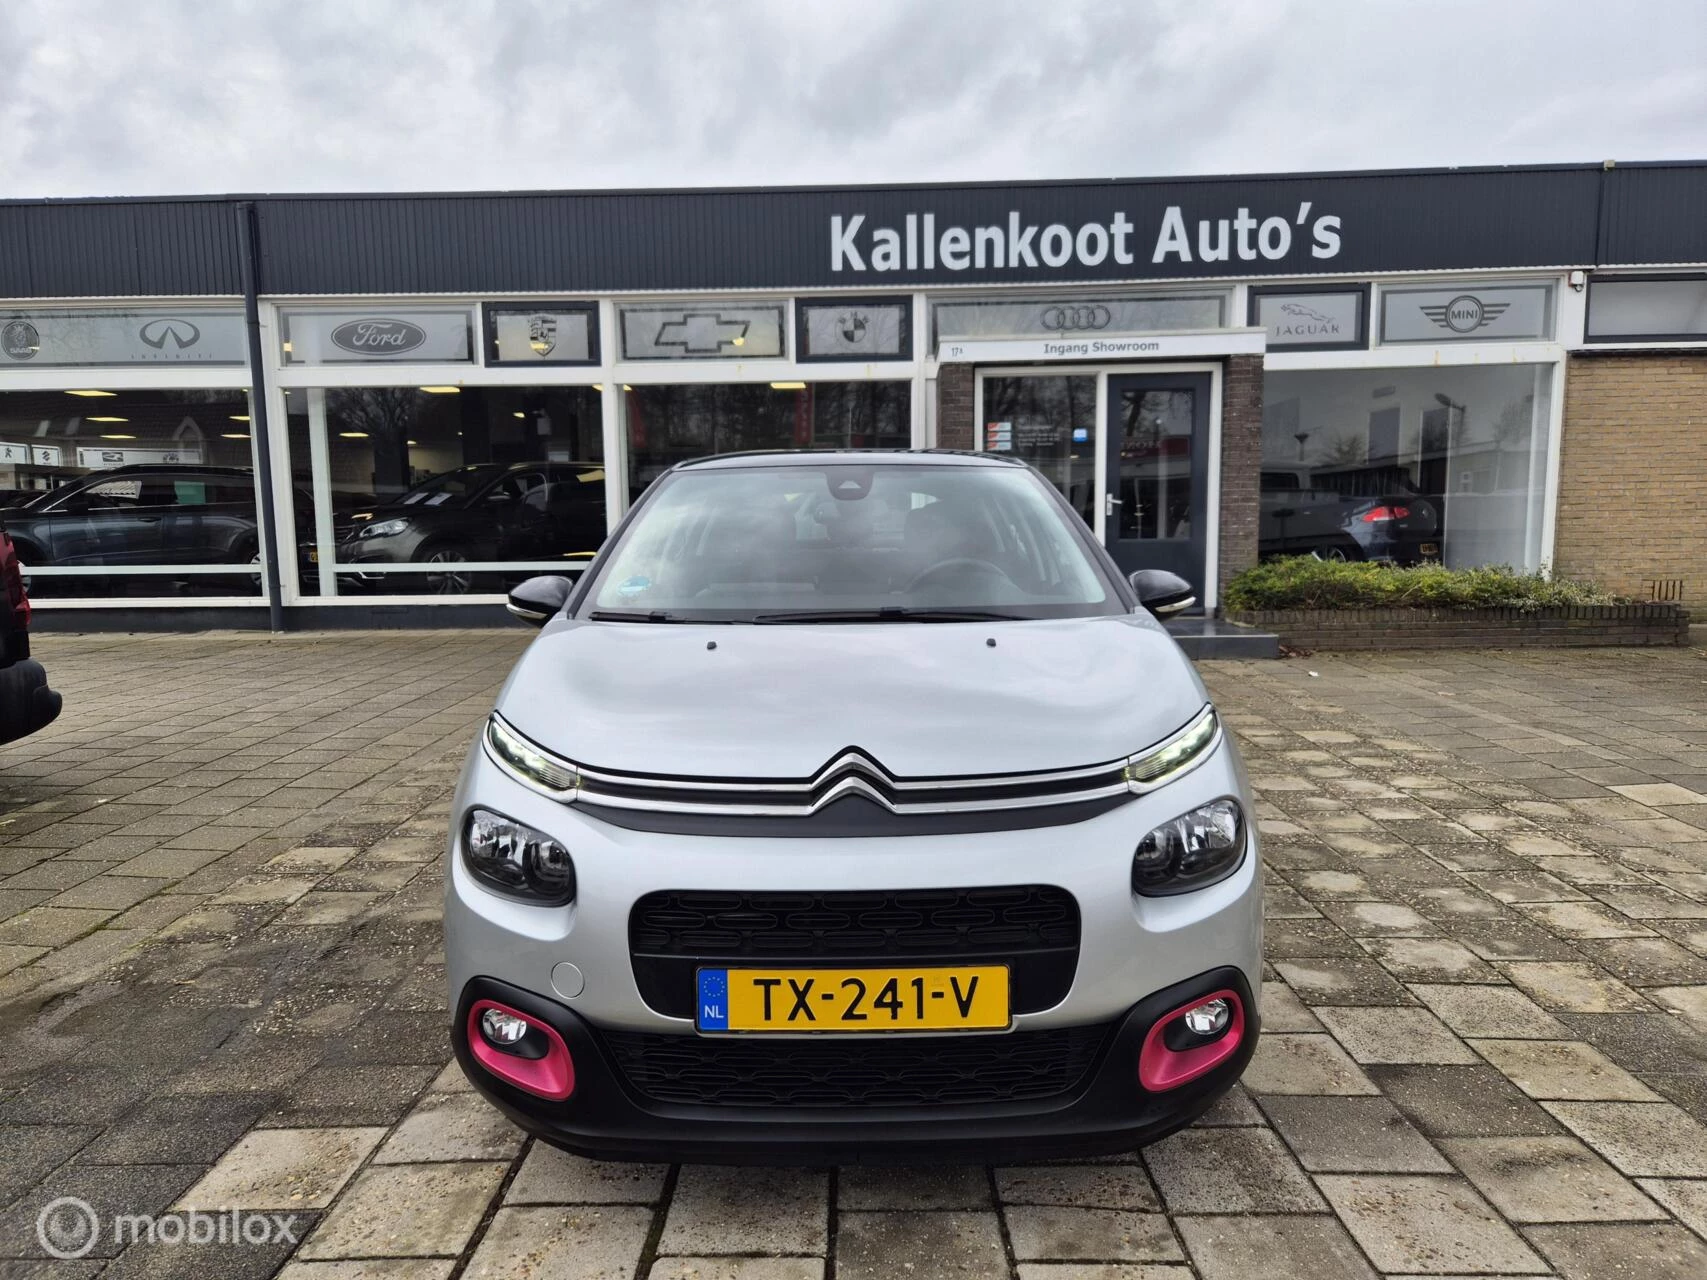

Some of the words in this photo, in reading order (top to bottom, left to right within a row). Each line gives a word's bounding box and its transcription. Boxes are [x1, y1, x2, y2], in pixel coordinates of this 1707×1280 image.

[830, 211, 1134, 271] Kallenkoot
[1151, 202, 1342, 263] Auto's
[1451, 310, 1478, 320] MINI
[352, 323, 407, 346] Ford
[1275, 324, 1340, 336] JAGUAR
[1043, 343, 1089, 356] Ingang
[1092, 341, 1160, 353] Showroom
[753, 975, 980, 1021] TX-241-V
[704, 1005, 725, 1019] NL
